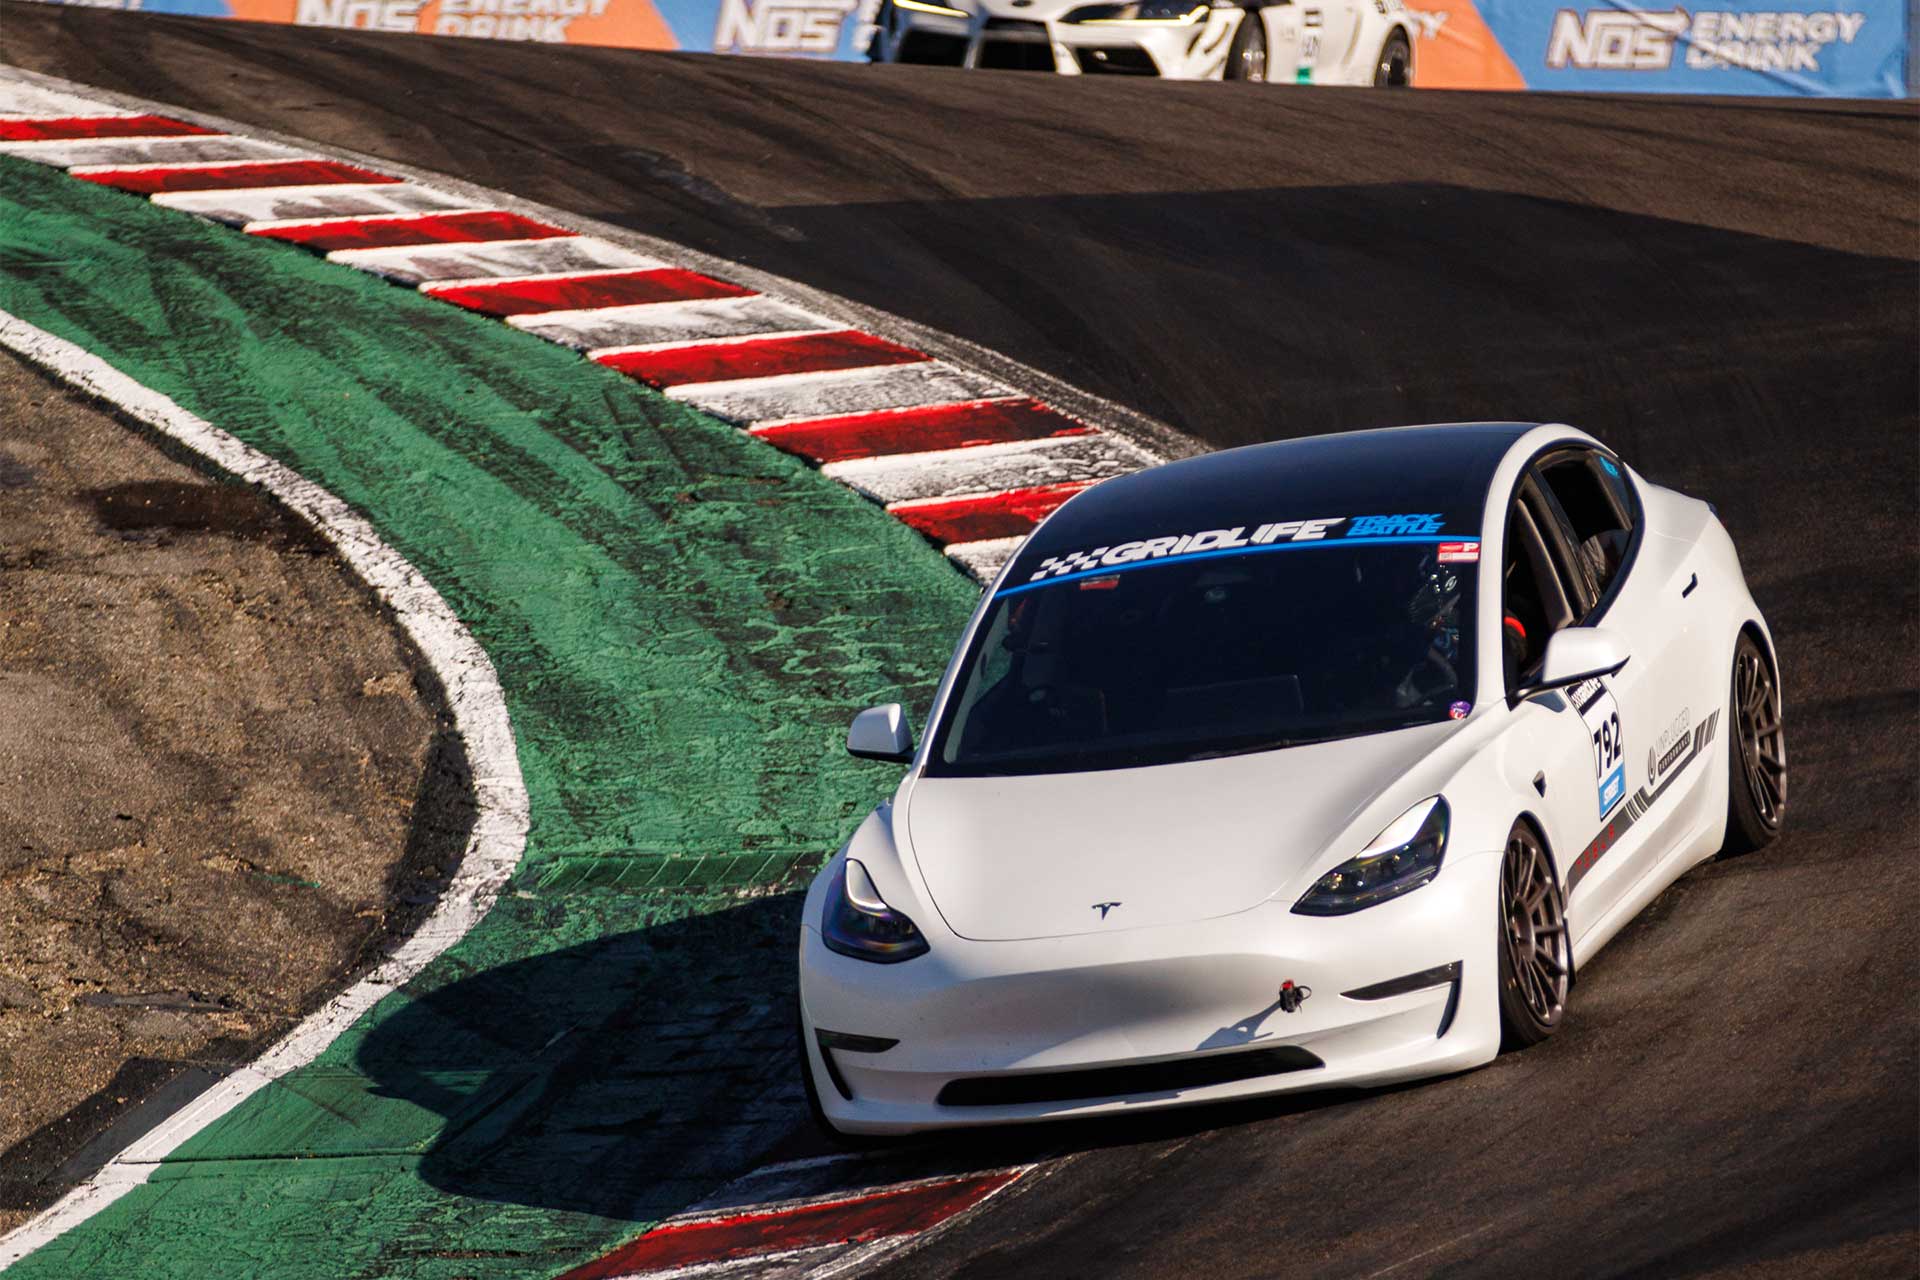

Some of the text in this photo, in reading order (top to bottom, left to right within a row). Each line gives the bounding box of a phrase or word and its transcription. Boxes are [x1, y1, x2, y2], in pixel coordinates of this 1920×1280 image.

[714, 0, 856, 52] NOS
[1546, 9, 1866, 69] NOS ENERGY
[1100, 517, 1347, 566] GRIDLIFE
[1593, 711, 1621, 779] 792
